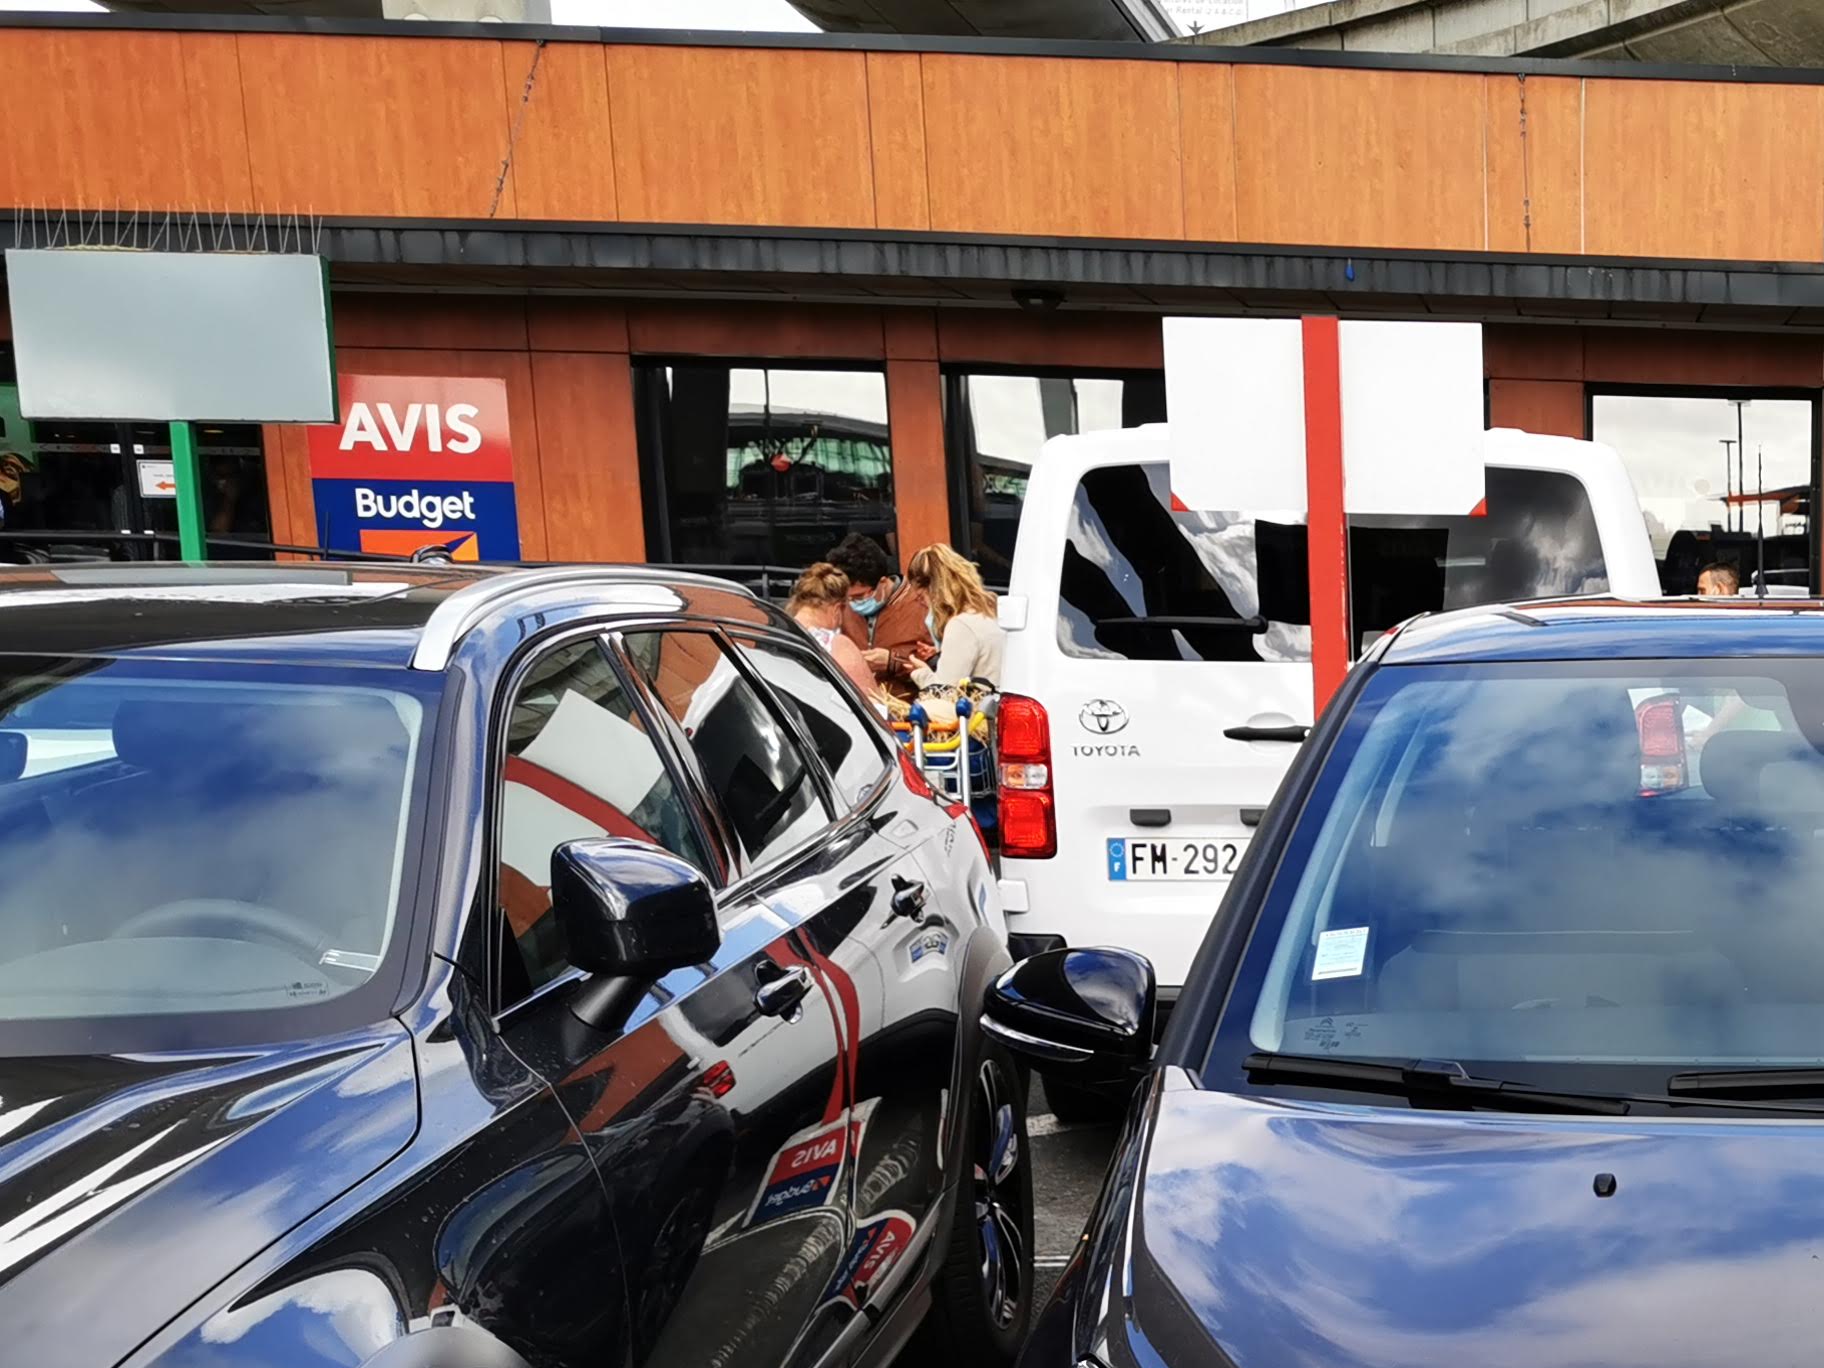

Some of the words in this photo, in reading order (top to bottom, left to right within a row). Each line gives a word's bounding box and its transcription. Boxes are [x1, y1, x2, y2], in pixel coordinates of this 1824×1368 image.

[338, 402, 482, 454] AVIS
[355, 488, 476, 528] Budget
[1073, 745, 1141, 757] TOYOTA
[1131, 843, 1238, 874] FM-292
